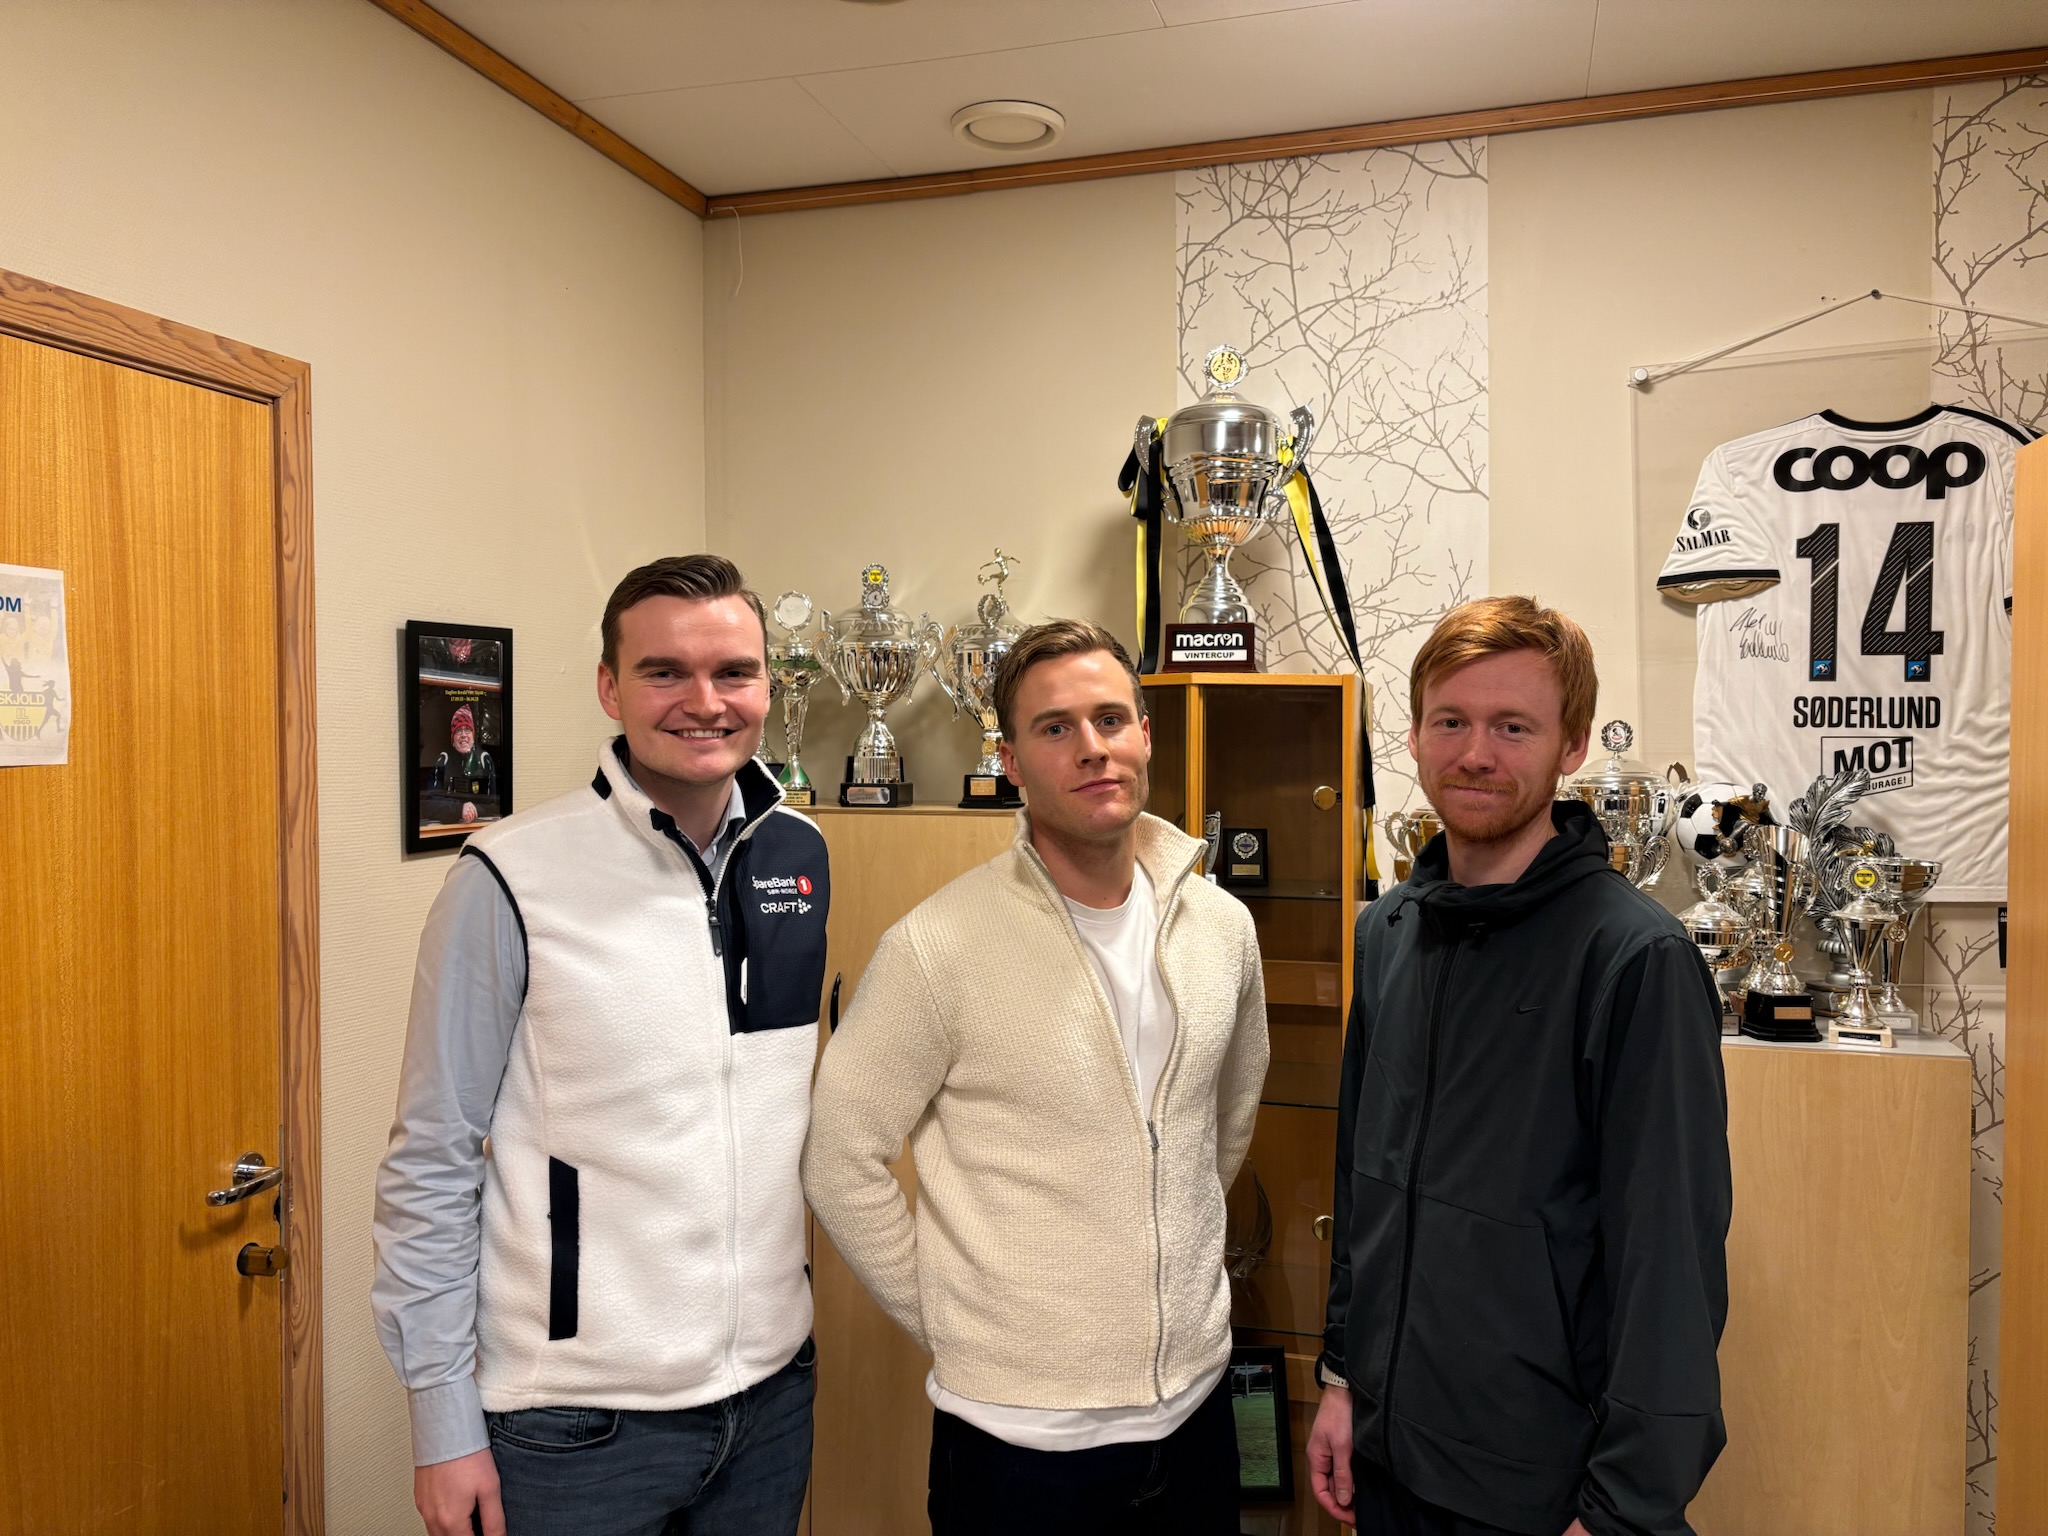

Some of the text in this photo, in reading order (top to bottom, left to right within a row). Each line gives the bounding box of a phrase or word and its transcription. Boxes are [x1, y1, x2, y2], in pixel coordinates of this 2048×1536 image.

[1773, 441, 1986, 500] coop
[1796, 521, 1944, 682] 14
[1176, 633, 1243, 647] macron
[1793, 696, 1941, 728] SØDERLUND
[1834, 737, 1913, 778] MOT
[752, 876, 808, 892] SpareBank 1
[760, 902, 797, 913] CRAFT
